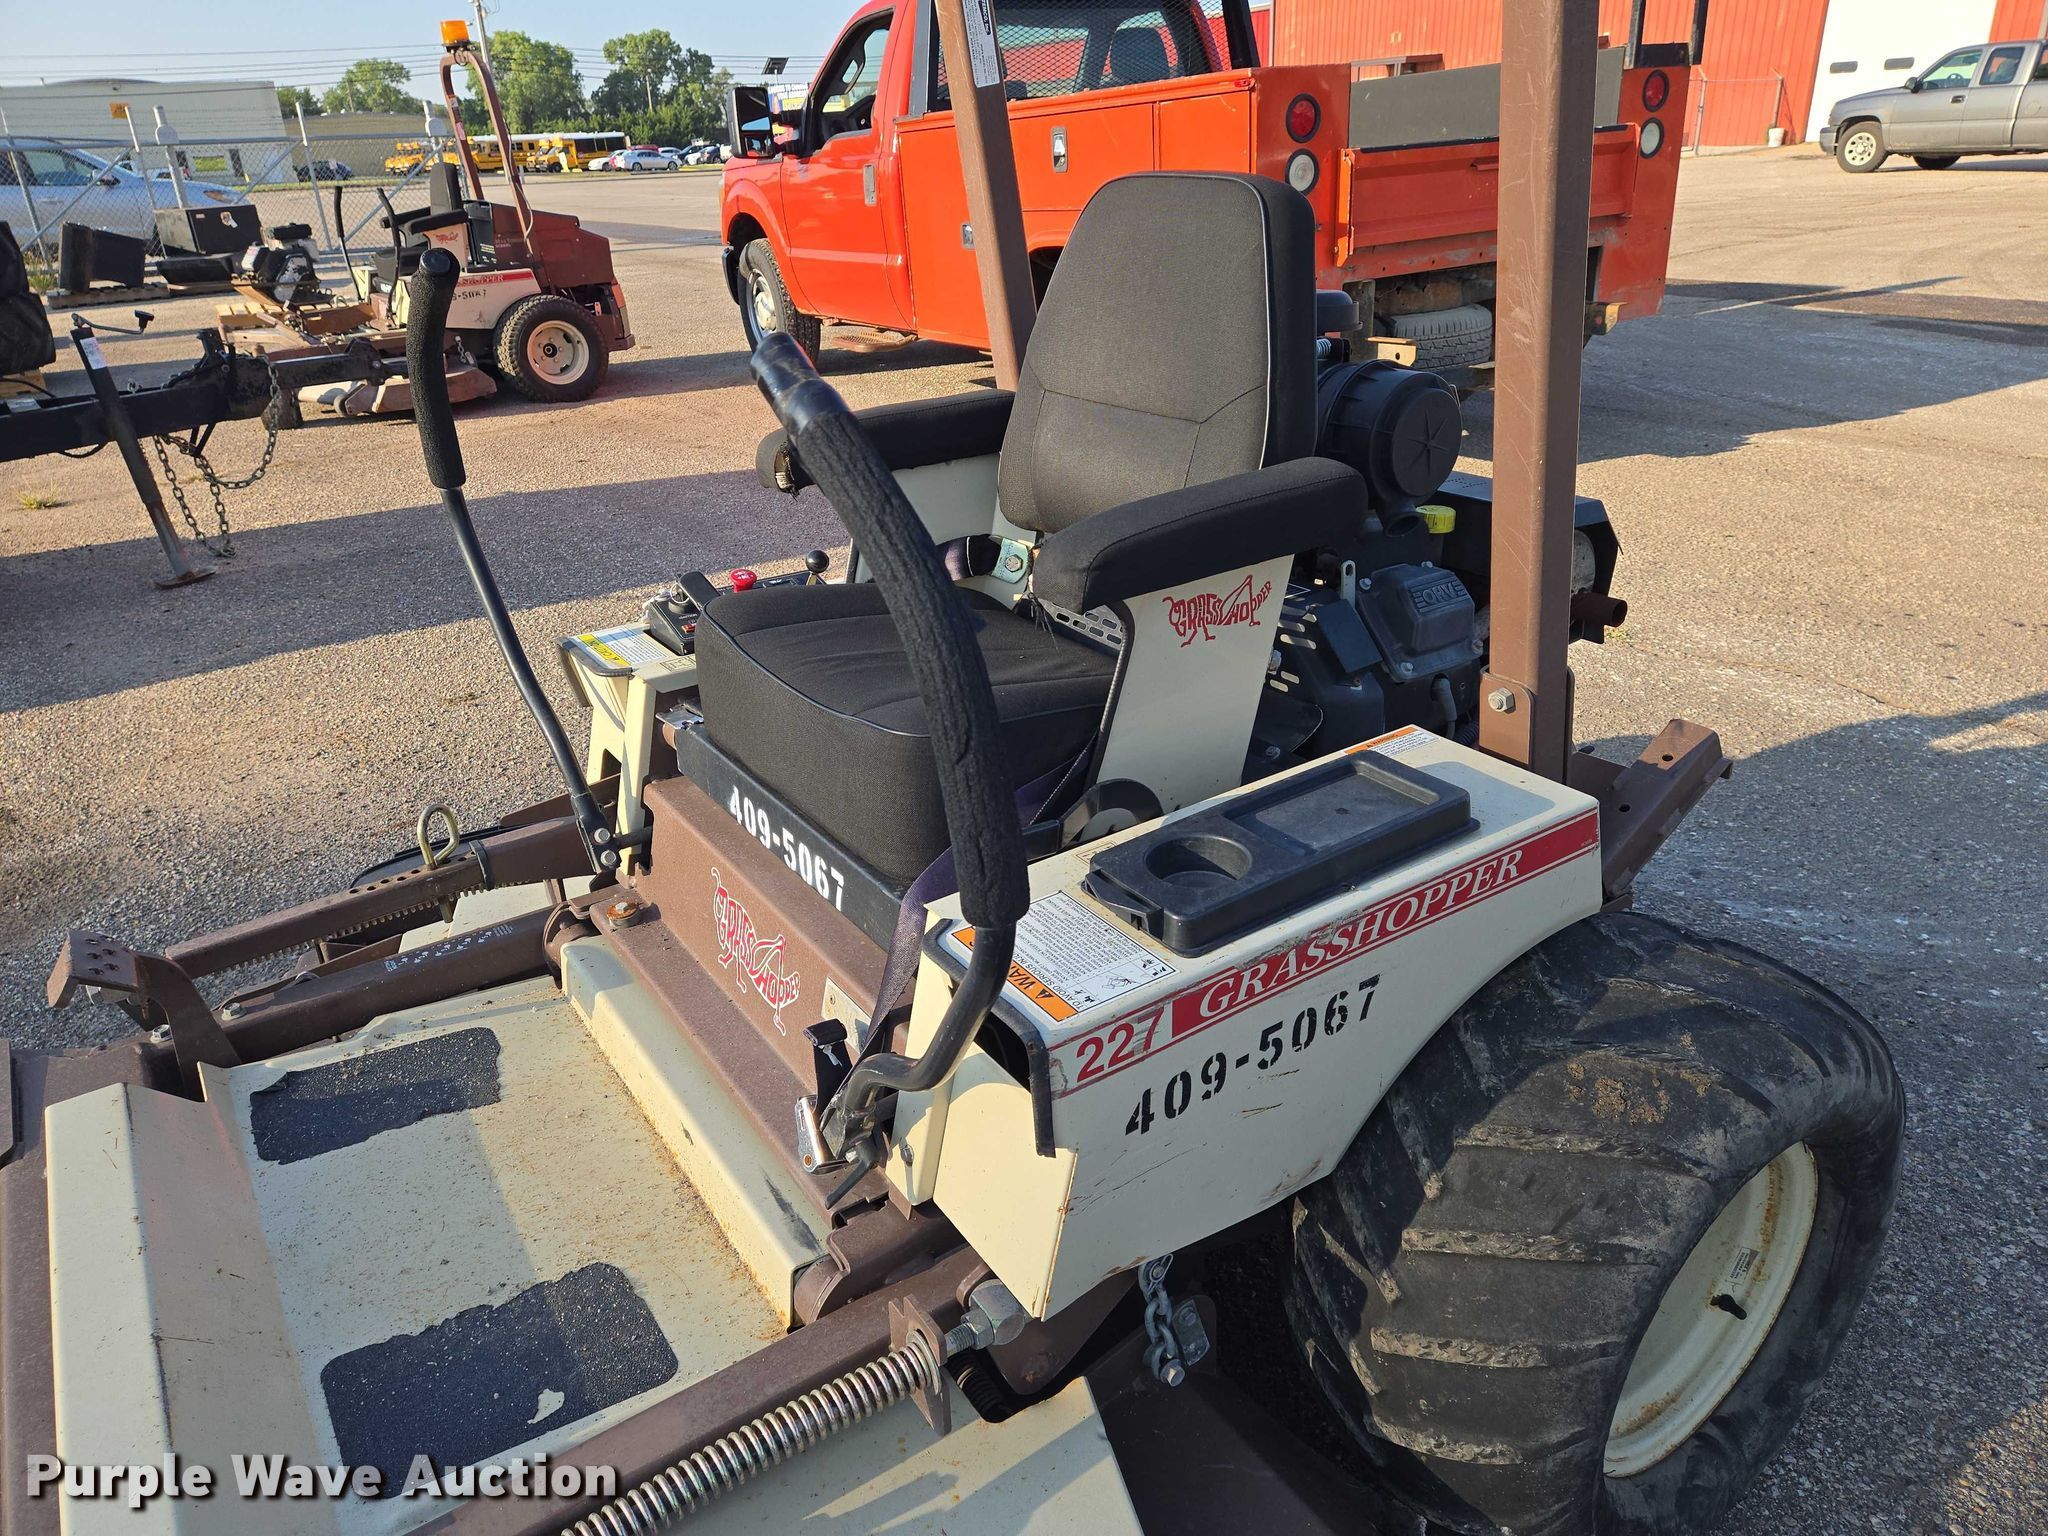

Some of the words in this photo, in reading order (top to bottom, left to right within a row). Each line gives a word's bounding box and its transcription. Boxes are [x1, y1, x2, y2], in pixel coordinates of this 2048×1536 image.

[730, 785, 844, 911] 409-5067
[1023, 962, 1056, 987] SERIOUS
[1050, 984, 1076, 1002] AVOID
[1076, 1006, 1165, 1083] 227
[1199, 849, 1522, 1018] GRASSHOPPER
[1069, 999, 1085, 1009] TO
[1125, 974, 1380, 1136] 409-5067
